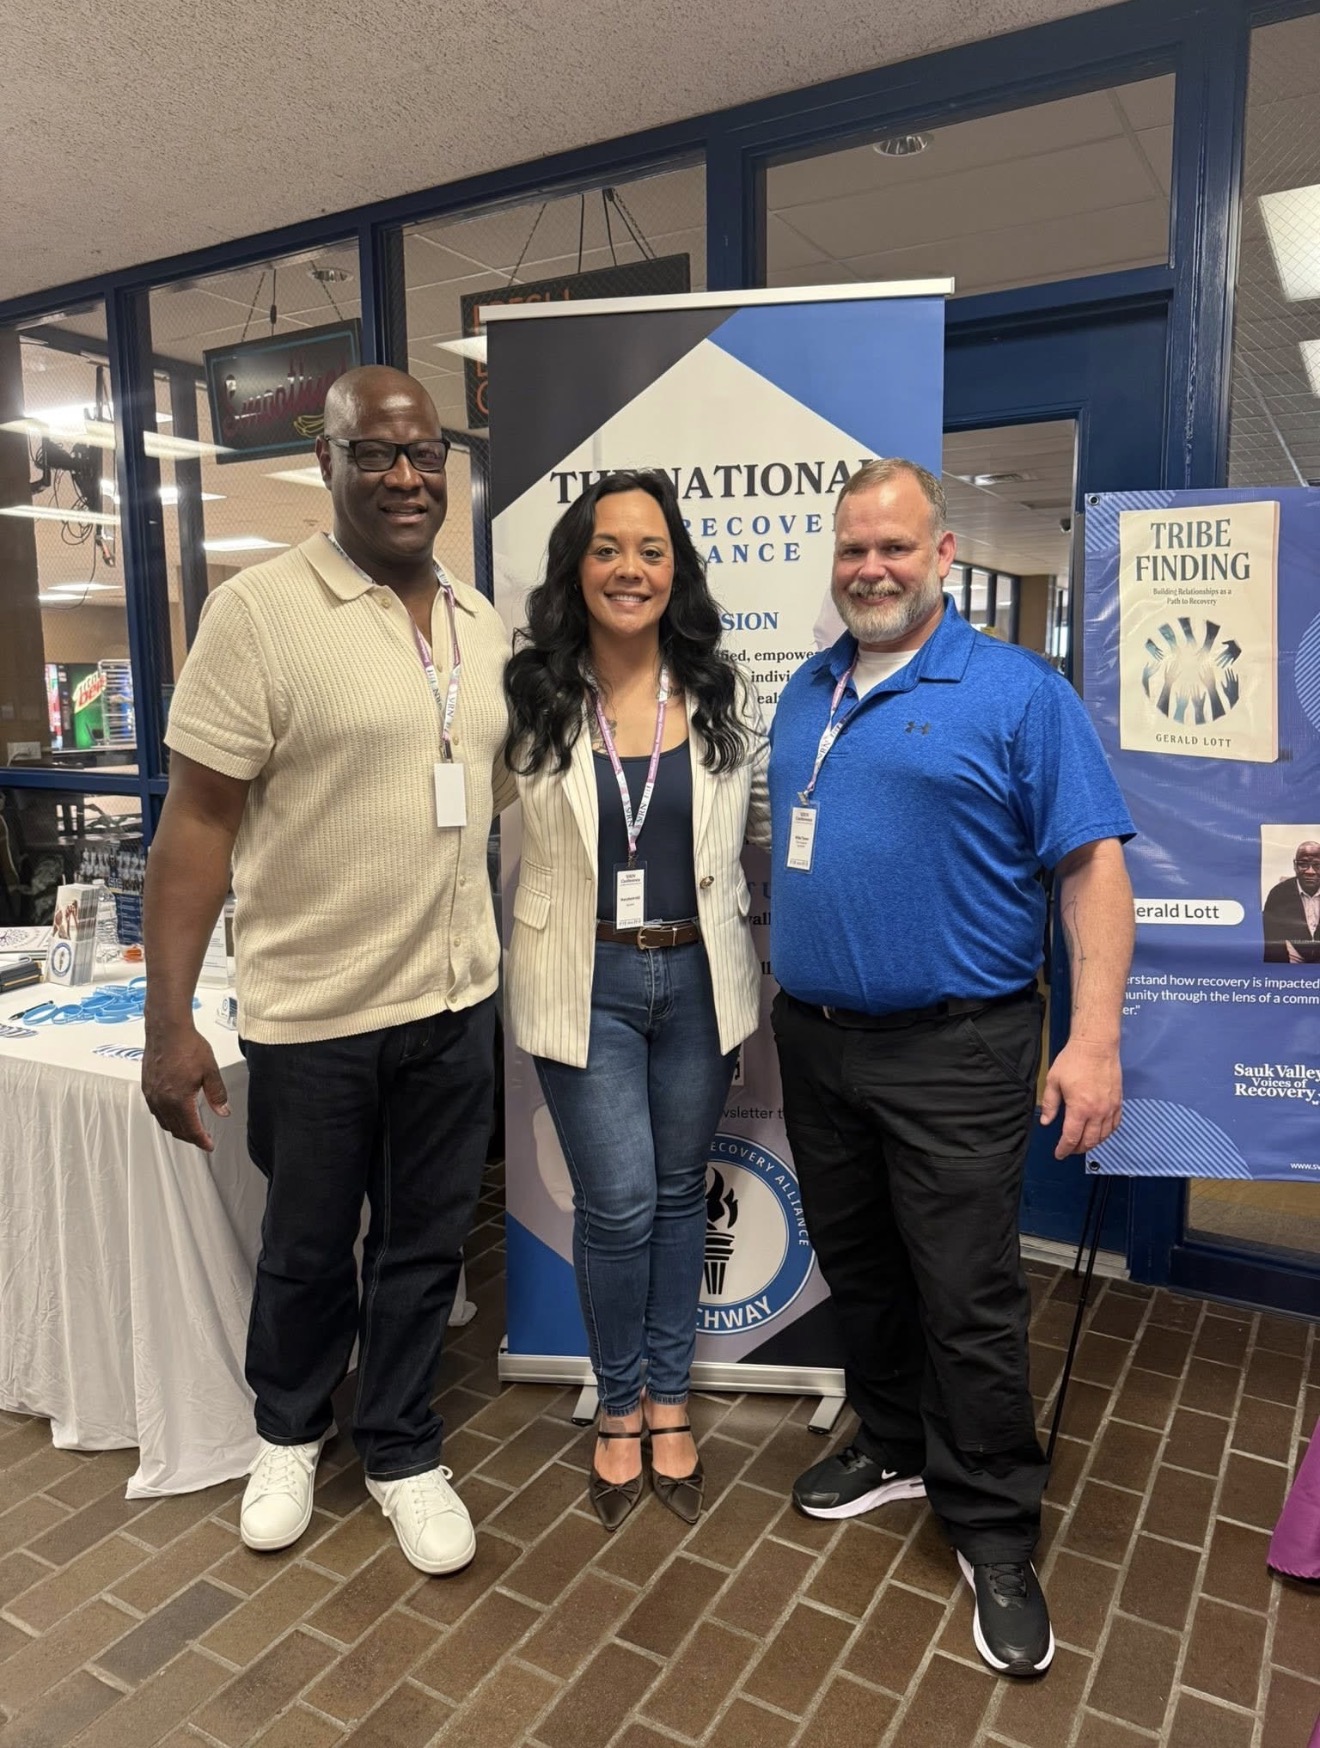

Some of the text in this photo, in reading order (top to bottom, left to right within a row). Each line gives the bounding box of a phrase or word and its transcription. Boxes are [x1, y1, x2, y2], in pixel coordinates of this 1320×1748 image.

[550, 458, 873, 504] TH NATIONA
[682, 513, 836, 537] ECOVE
[1150, 518, 1231, 549] TRIBE
[707, 542, 800, 564] ANCE
[1135, 552, 1250, 581] FINDING
[1153, 588, 1177, 596] Building
[1178, 588, 1218, 596] Relationships
[1189, 597, 1217, 606] Recovery
[720, 612, 779, 631] SION
[751, 670, 790, 683] indivi
[757, 692, 780, 704] eal
[1156, 733, 1232, 748] GERALD LOTT
[1136, 903, 1220, 918] erald Lott
[1127, 974, 1320, 990] rstand how recovery is impacted
[1161, 990, 1208, 1003] through
[1210, 991, 1230, 1002] the
[1232, 991, 1256, 1003] lens
[1258, 992, 1272, 1003] of
[1273, 994, 1280, 1003] a
[1122, 1004, 1141, 1015] er."
[1234, 1063, 1274, 1077] Sauk
[1252, 1078, 1308, 1088] Voices of
[1234, 1083, 1316, 1102] Recovery
[710, 1141, 809, 1246] ECOVERY ALLIANCE
